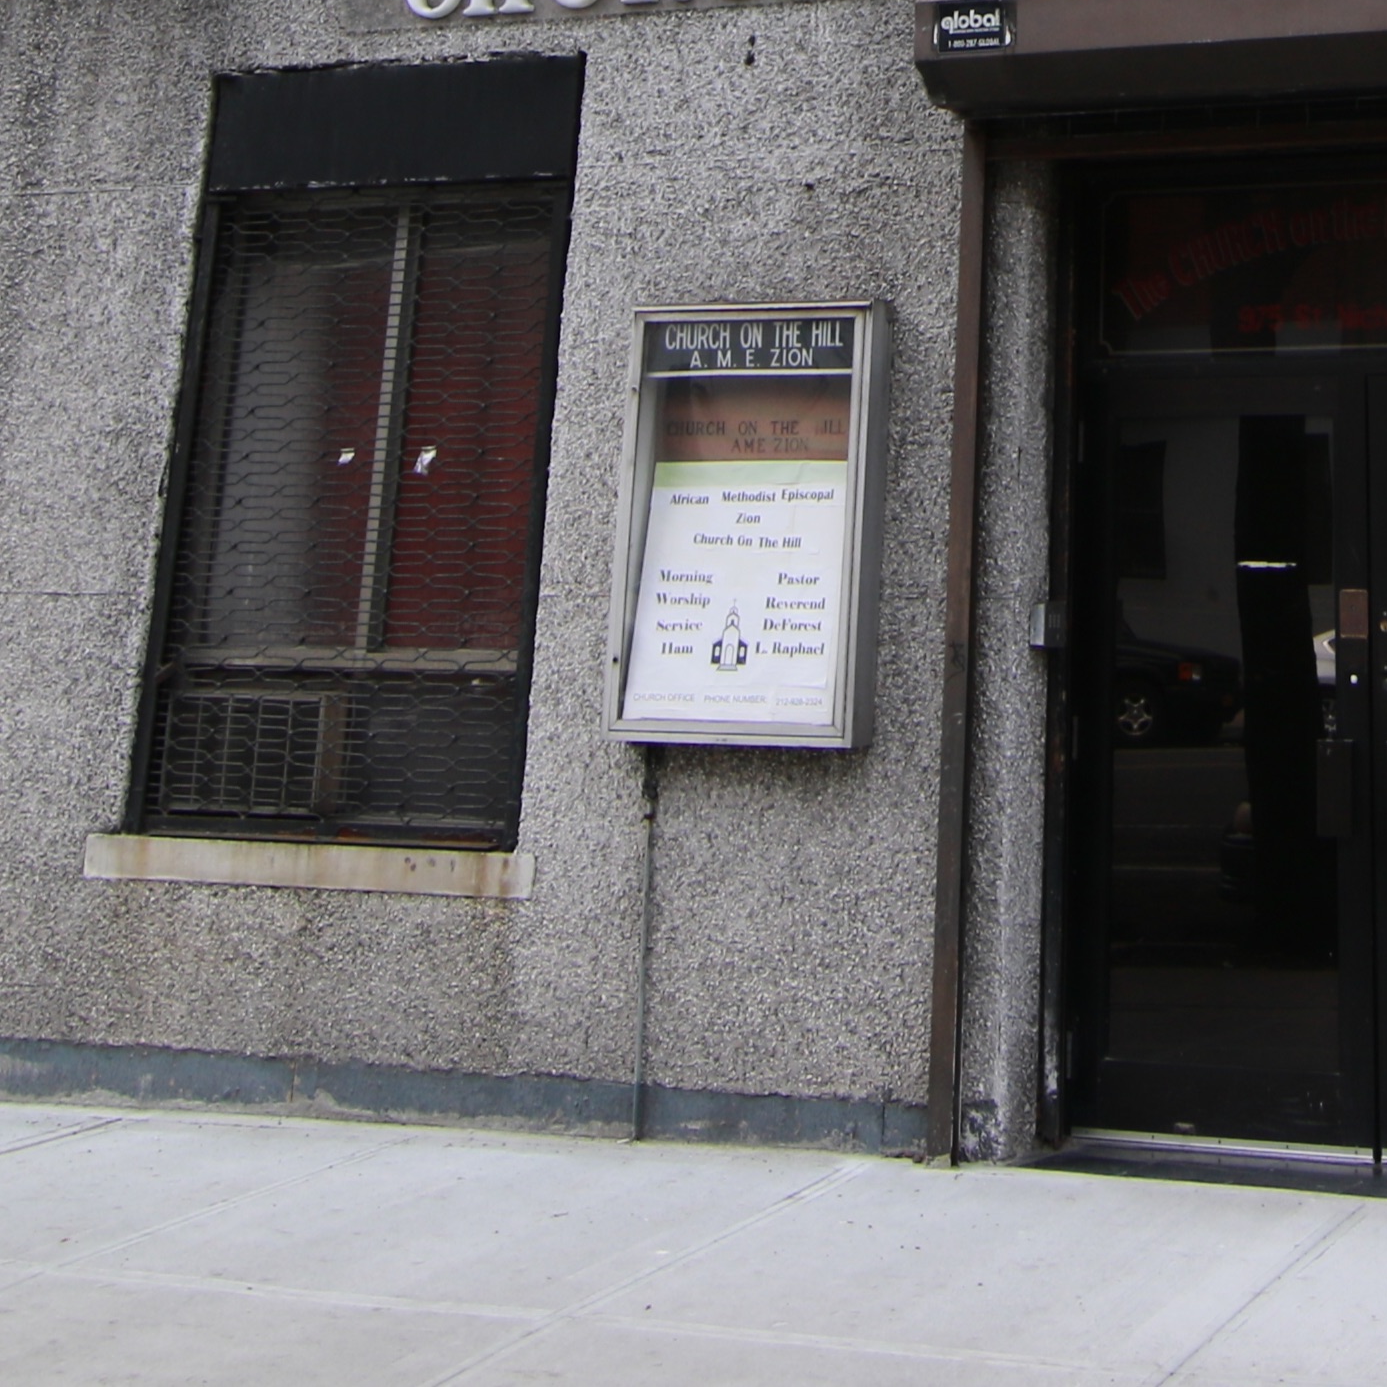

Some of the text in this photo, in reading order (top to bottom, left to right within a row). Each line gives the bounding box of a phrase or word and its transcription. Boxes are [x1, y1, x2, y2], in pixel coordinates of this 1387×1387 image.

[941, 8, 1001, 35] global
[665, 320, 843, 350] CHURCH ON THE HILL
[770, 348, 813, 367] ZION
[738, 420, 757, 435] ON
[771, 420, 800, 435] THE
[670, 488, 835, 506] African Methodist Episcopal
[736, 512, 761, 524] Zion
[693, 533, 802, 548] Church On The Hill
[660, 569, 713, 584] Morning
[778, 572, 820, 586] Pastor
[656, 592, 711, 609] Worship
[765, 596, 826, 610] Reverend
[656, 619, 703, 631] Service
[763, 618, 822, 631] DeForest
[772, 641, 825, 658] Raphael
[633, 692, 666, 702] CHURCH
[667, 693, 695, 702] OFFICE
[704, 693, 731, 703] PHONE
